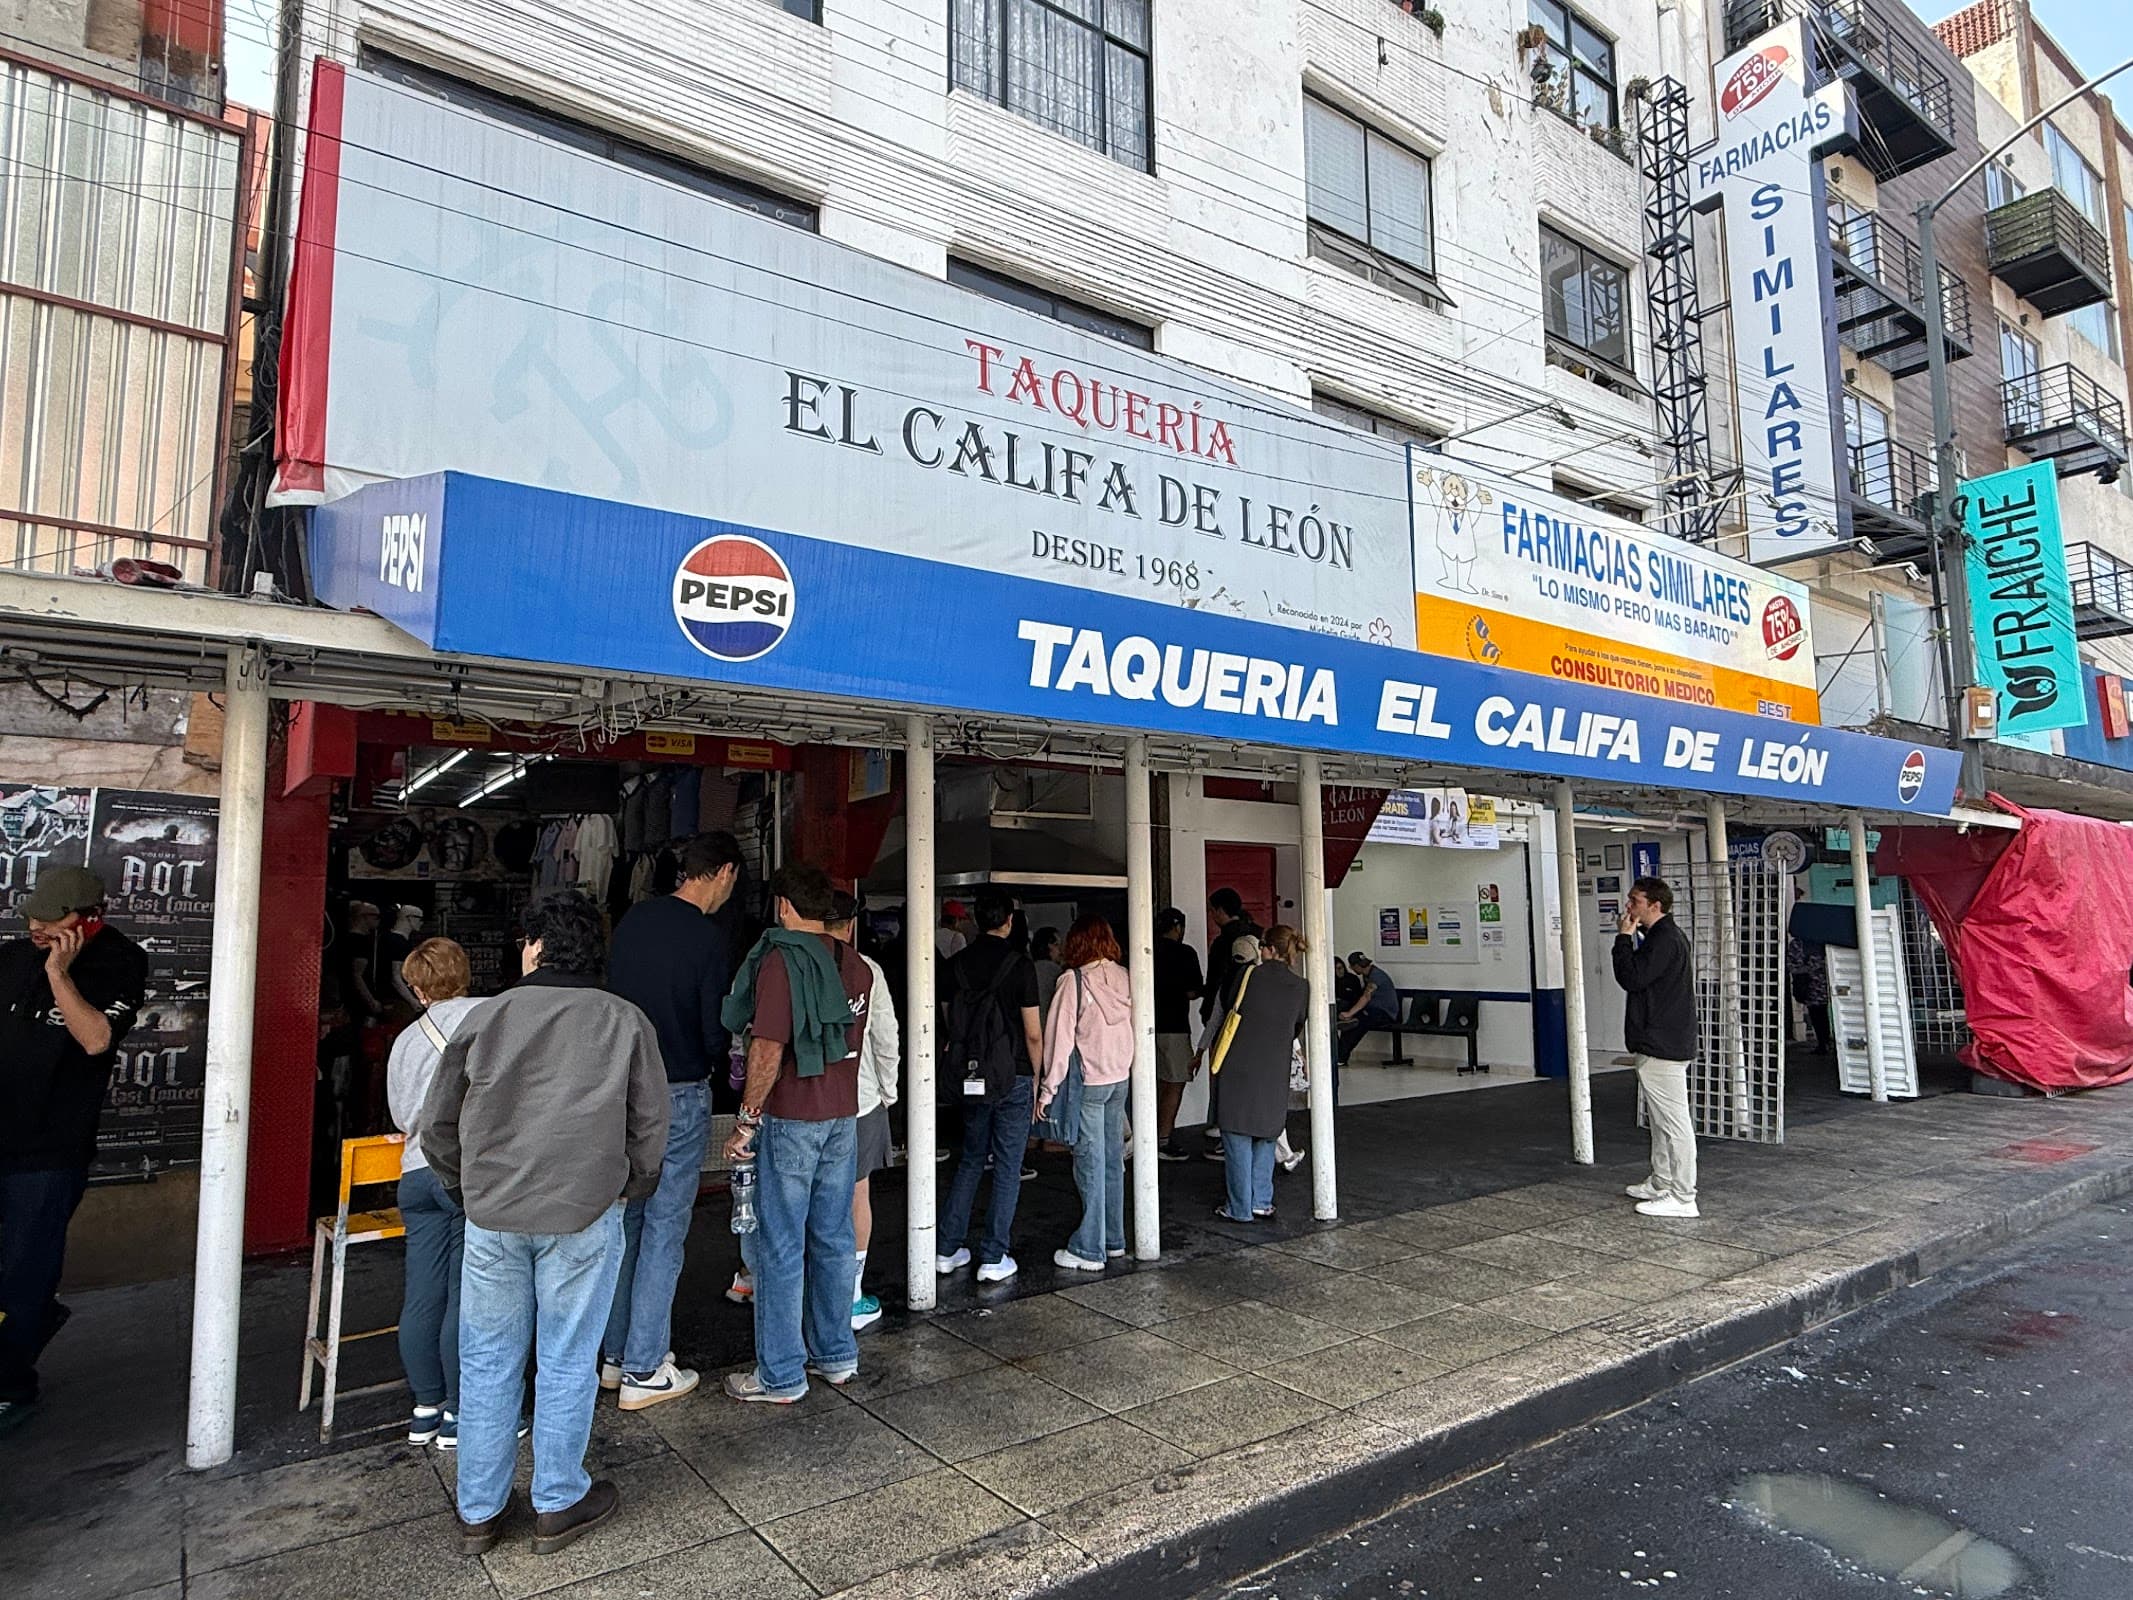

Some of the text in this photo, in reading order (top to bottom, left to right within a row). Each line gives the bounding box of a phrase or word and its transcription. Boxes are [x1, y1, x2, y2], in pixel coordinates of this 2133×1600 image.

[1729, 53, 1778, 101] 75%
[1733, 55, 1761, 82] HASTA
[1700, 102, 1831, 189] FARMACIAS
[1750, 183, 1809, 538] SIMILARES
[966, 339, 1240, 466] TAQUERÍA
[784, 370, 1354, 572] EL CALIFA DE LEÓN
[380, 512, 428, 593] PEPSI
[1032, 530, 1200, 591] DESDE 1968
[1501, 500, 1750, 625] FARMACIAS SIMILARES
[680, 579, 789, 617] PEPSI
[1277, 604, 1363, 630] Reconocido en 2024 por
[1562, 585, 1611, 612] MISMO
[1615, 599, 1651, 622] PERO
[1654, 611, 1682, 632] MAS
[1766, 606, 1795, 642] 75%
[1018, 619, 1829, 786] TAQUERIA EL CALIFA DE LEÓN
[1550, 655, 1715, 706] CONSULTORIO MEDICO
[1758, 700, 1791, 719] BEST
[672, 739, 692, 747] VISA
[1901, 770, 1923, 783] PEPSI
[1331, 805, 1366, 824] LEÓN
[166, 895, 215, 914] Concer
[150, 1084, 202, 1106] Concer
